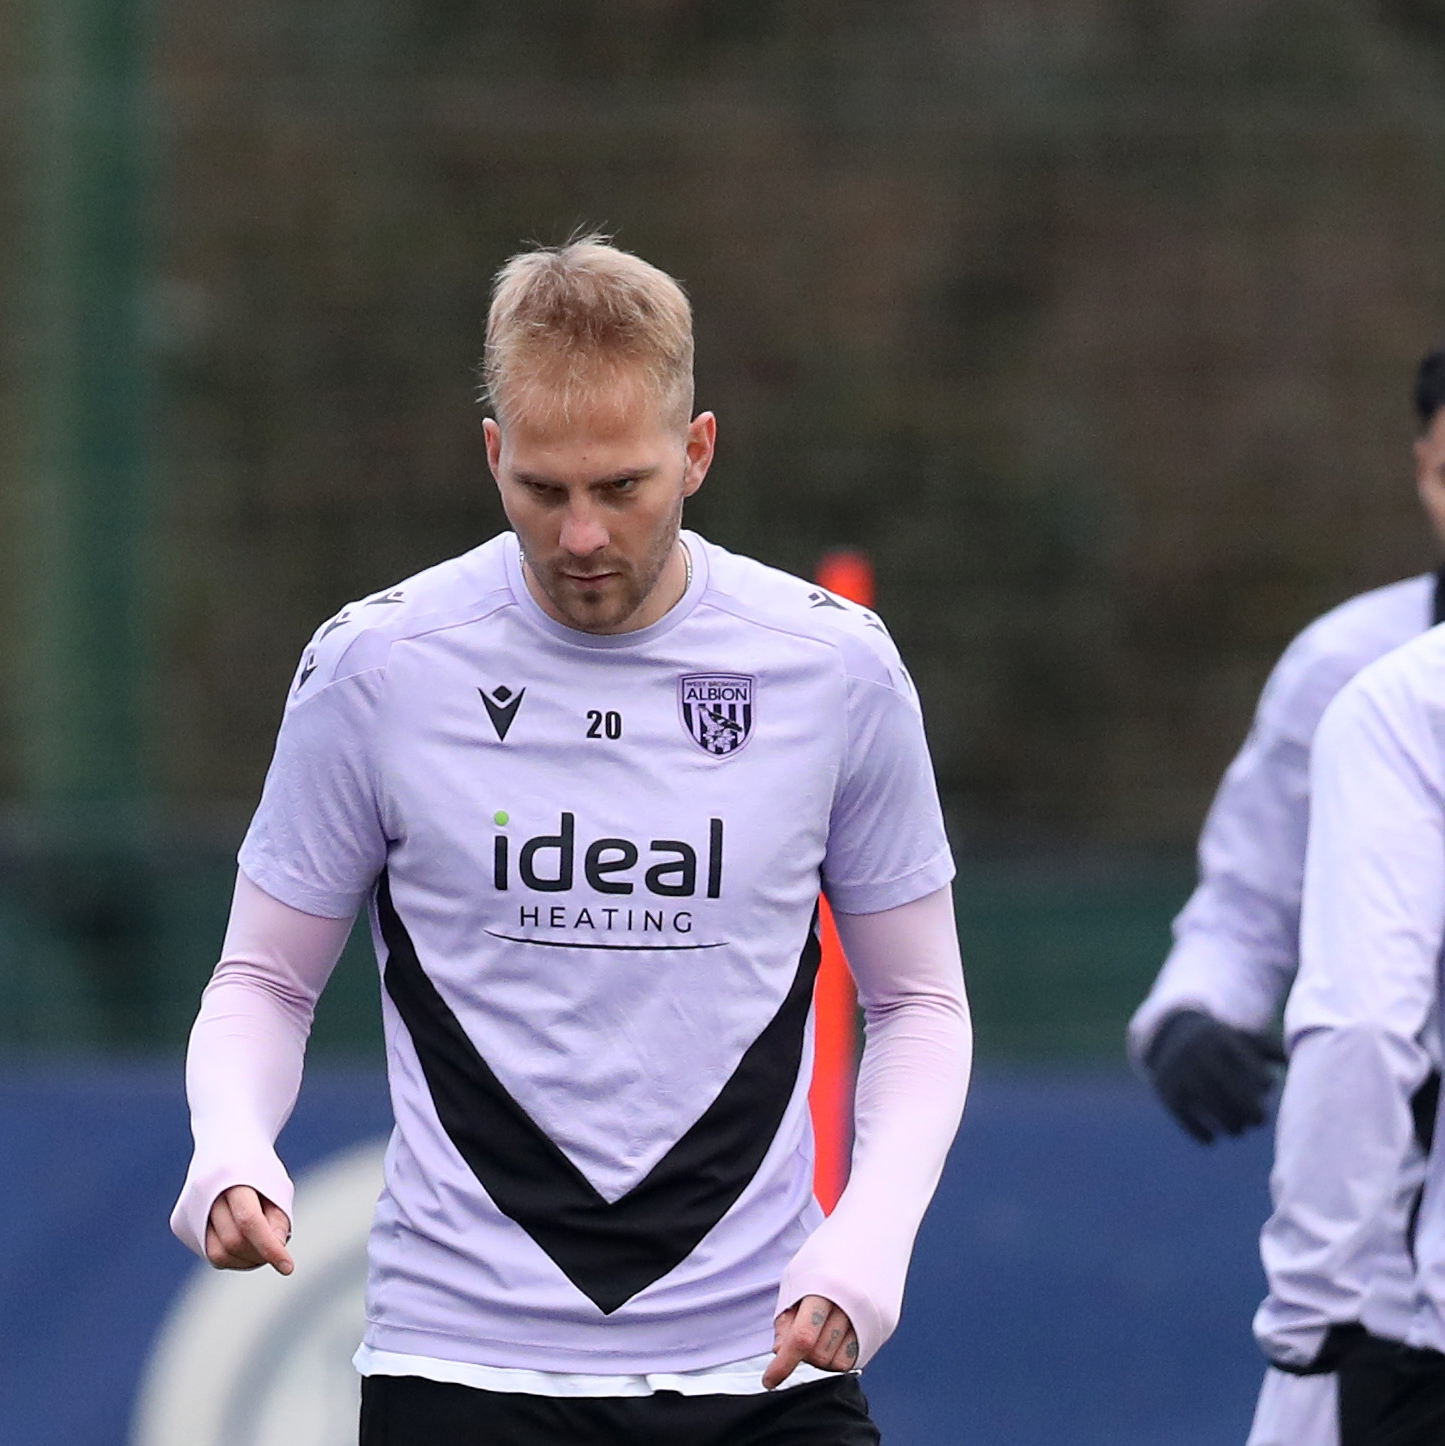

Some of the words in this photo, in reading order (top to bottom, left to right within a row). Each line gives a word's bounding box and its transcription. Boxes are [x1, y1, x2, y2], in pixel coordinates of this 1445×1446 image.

[686, 687, 747, 701] ALBION
[586, 709, 622, 740] 20
[493, 810, 724, 899] ideal
[519, 905, 694, 934] HEATING
